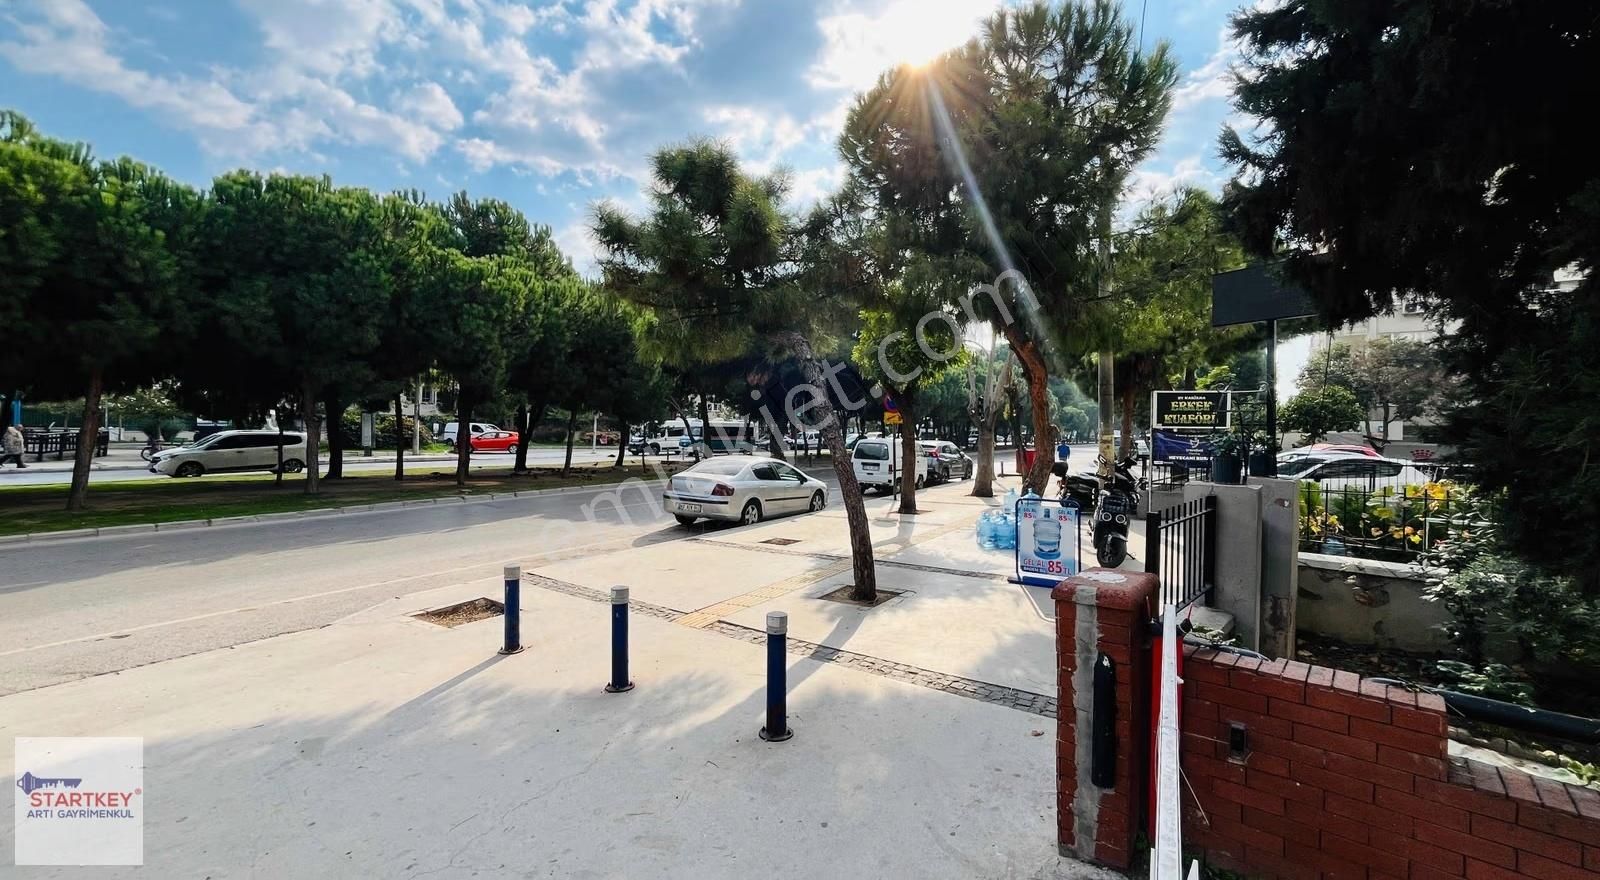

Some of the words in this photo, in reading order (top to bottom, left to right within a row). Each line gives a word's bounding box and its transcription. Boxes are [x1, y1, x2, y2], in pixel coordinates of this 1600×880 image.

[1171, 401, 1213, 411] ERKEK
[1023, 558, 1034, 566] GEL
[1036, 559, 1045, 567] AL
[1047, 560, 1062, 573] 85
[1063, 567, 1072, 576] TL
